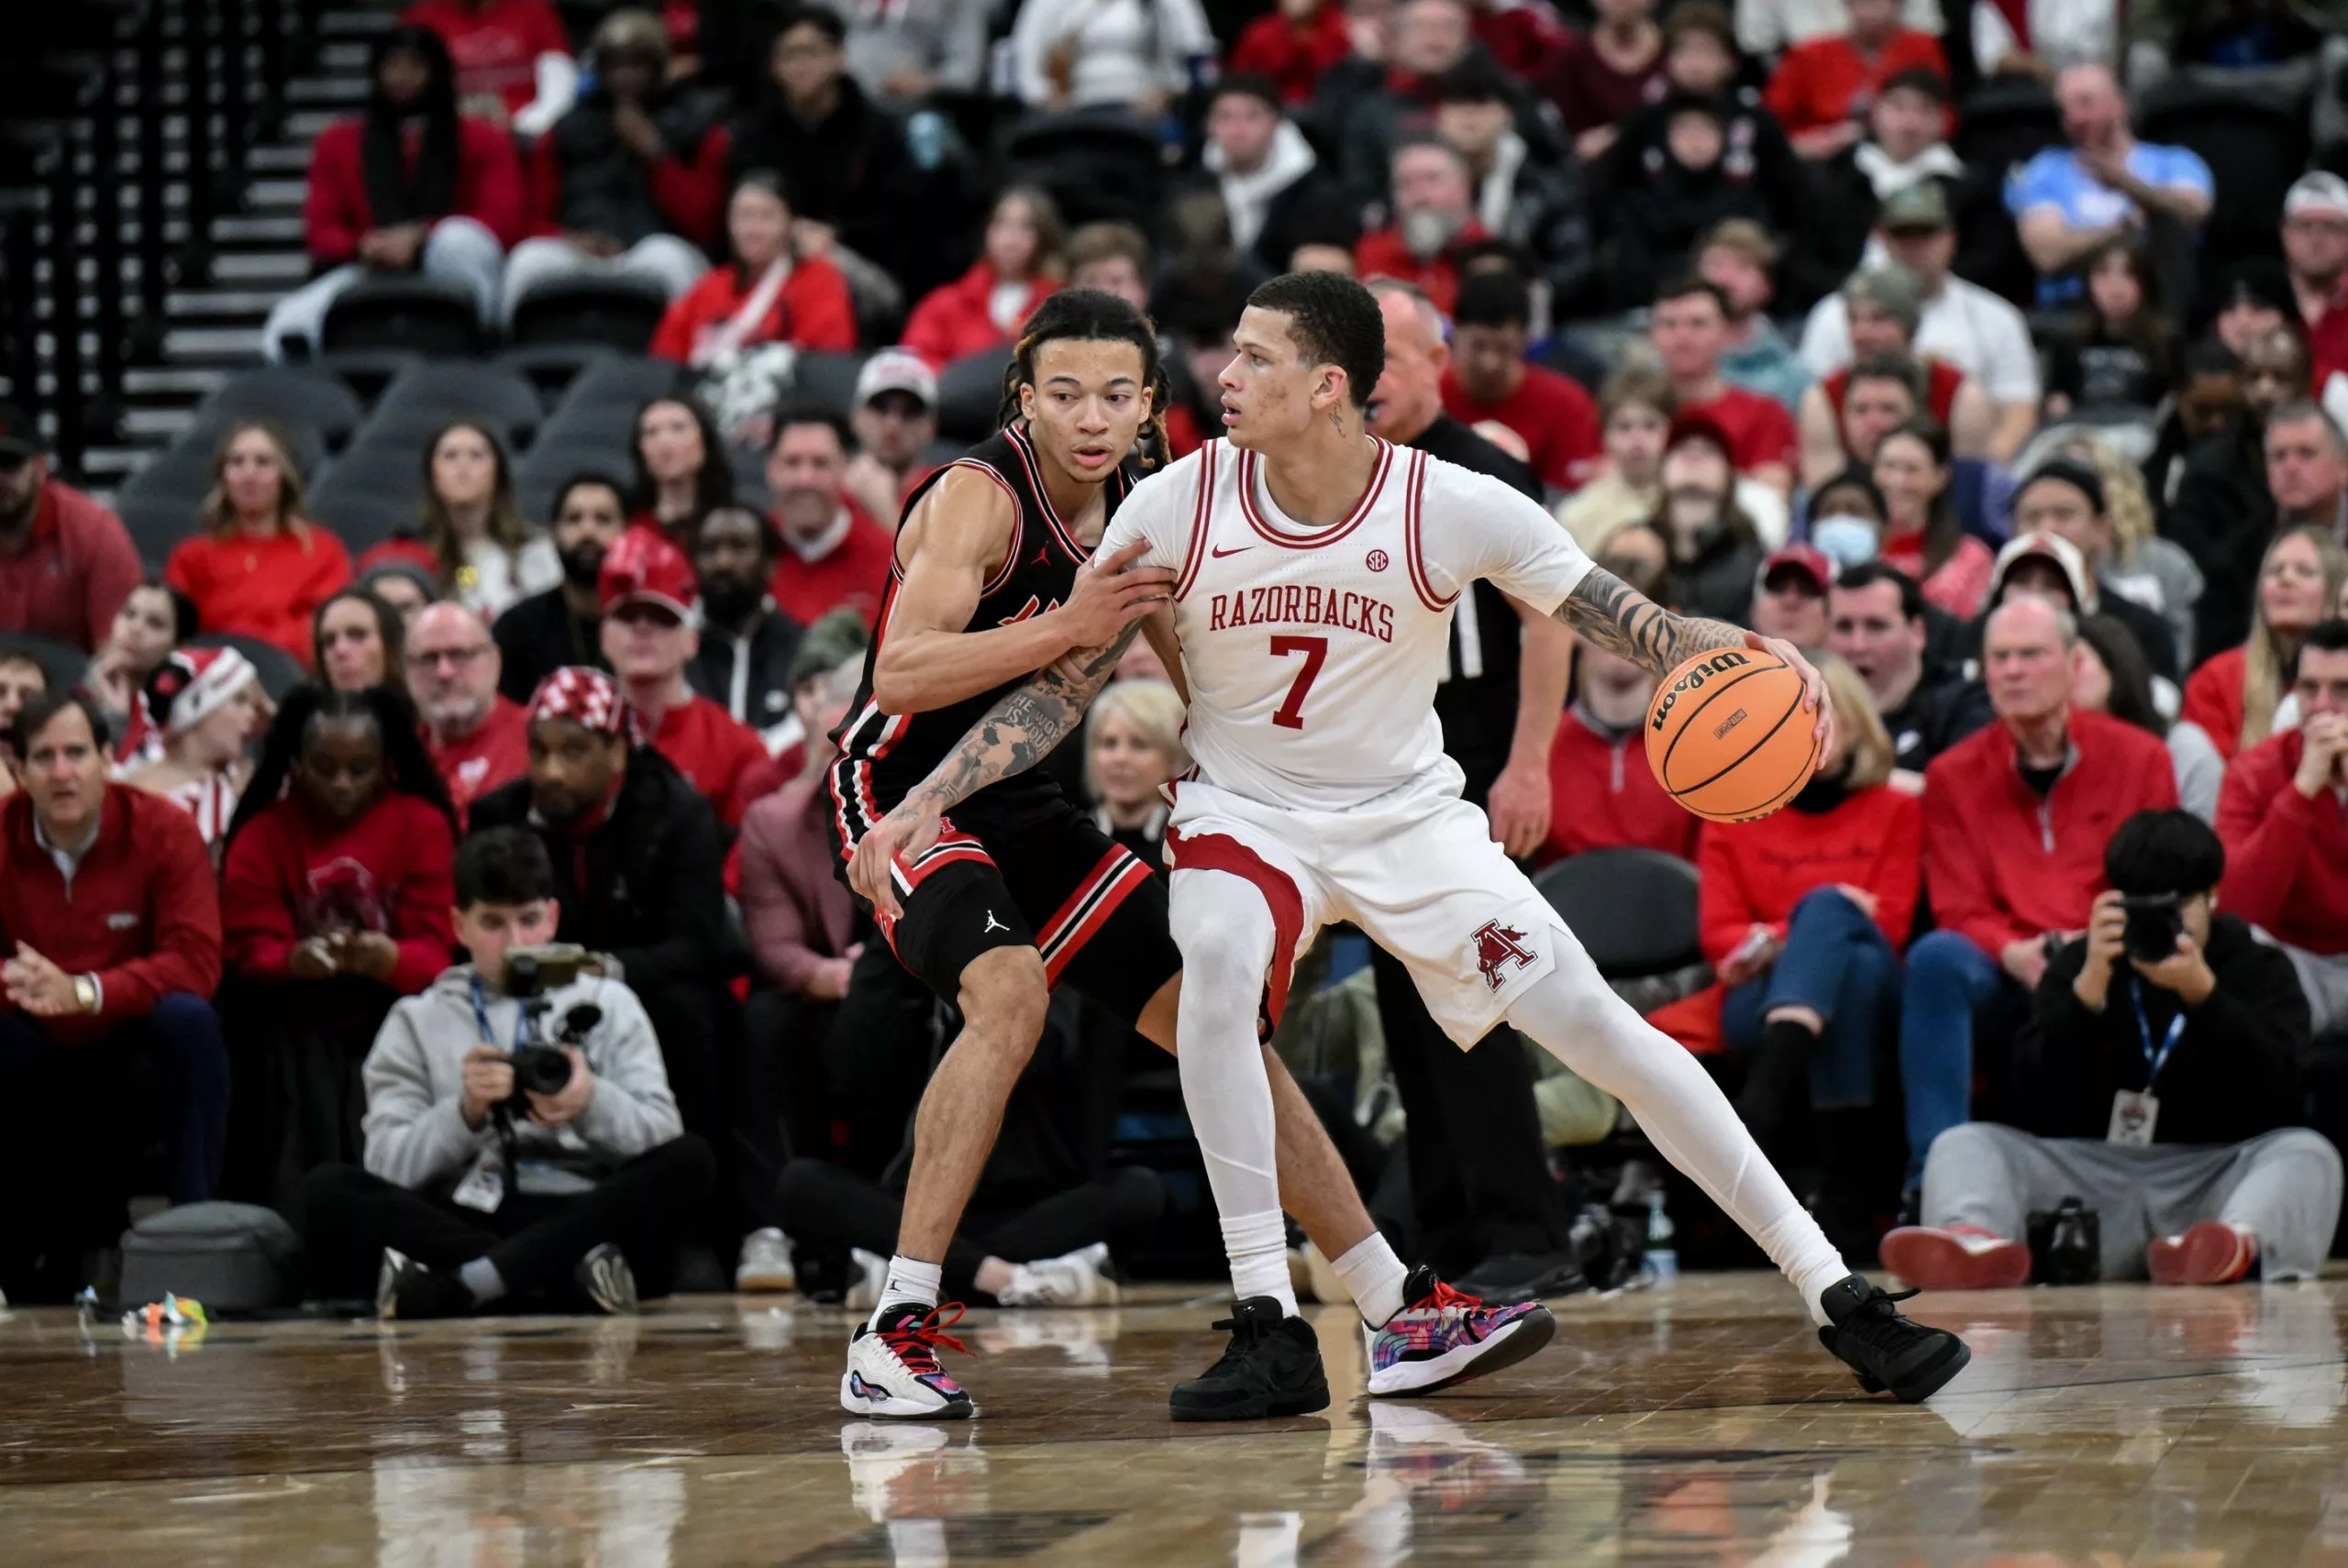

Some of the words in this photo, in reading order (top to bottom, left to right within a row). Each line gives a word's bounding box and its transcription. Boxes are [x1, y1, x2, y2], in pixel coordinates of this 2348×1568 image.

[1367, 550, 1388, 571] SEC
[1210, 585, 1394, 643] RAZORBACKS
[1270, 635, 1328, 730] 7
[1652, 652, 1751, 732] Wilson
[1005, 705, 1022, 724] IS
